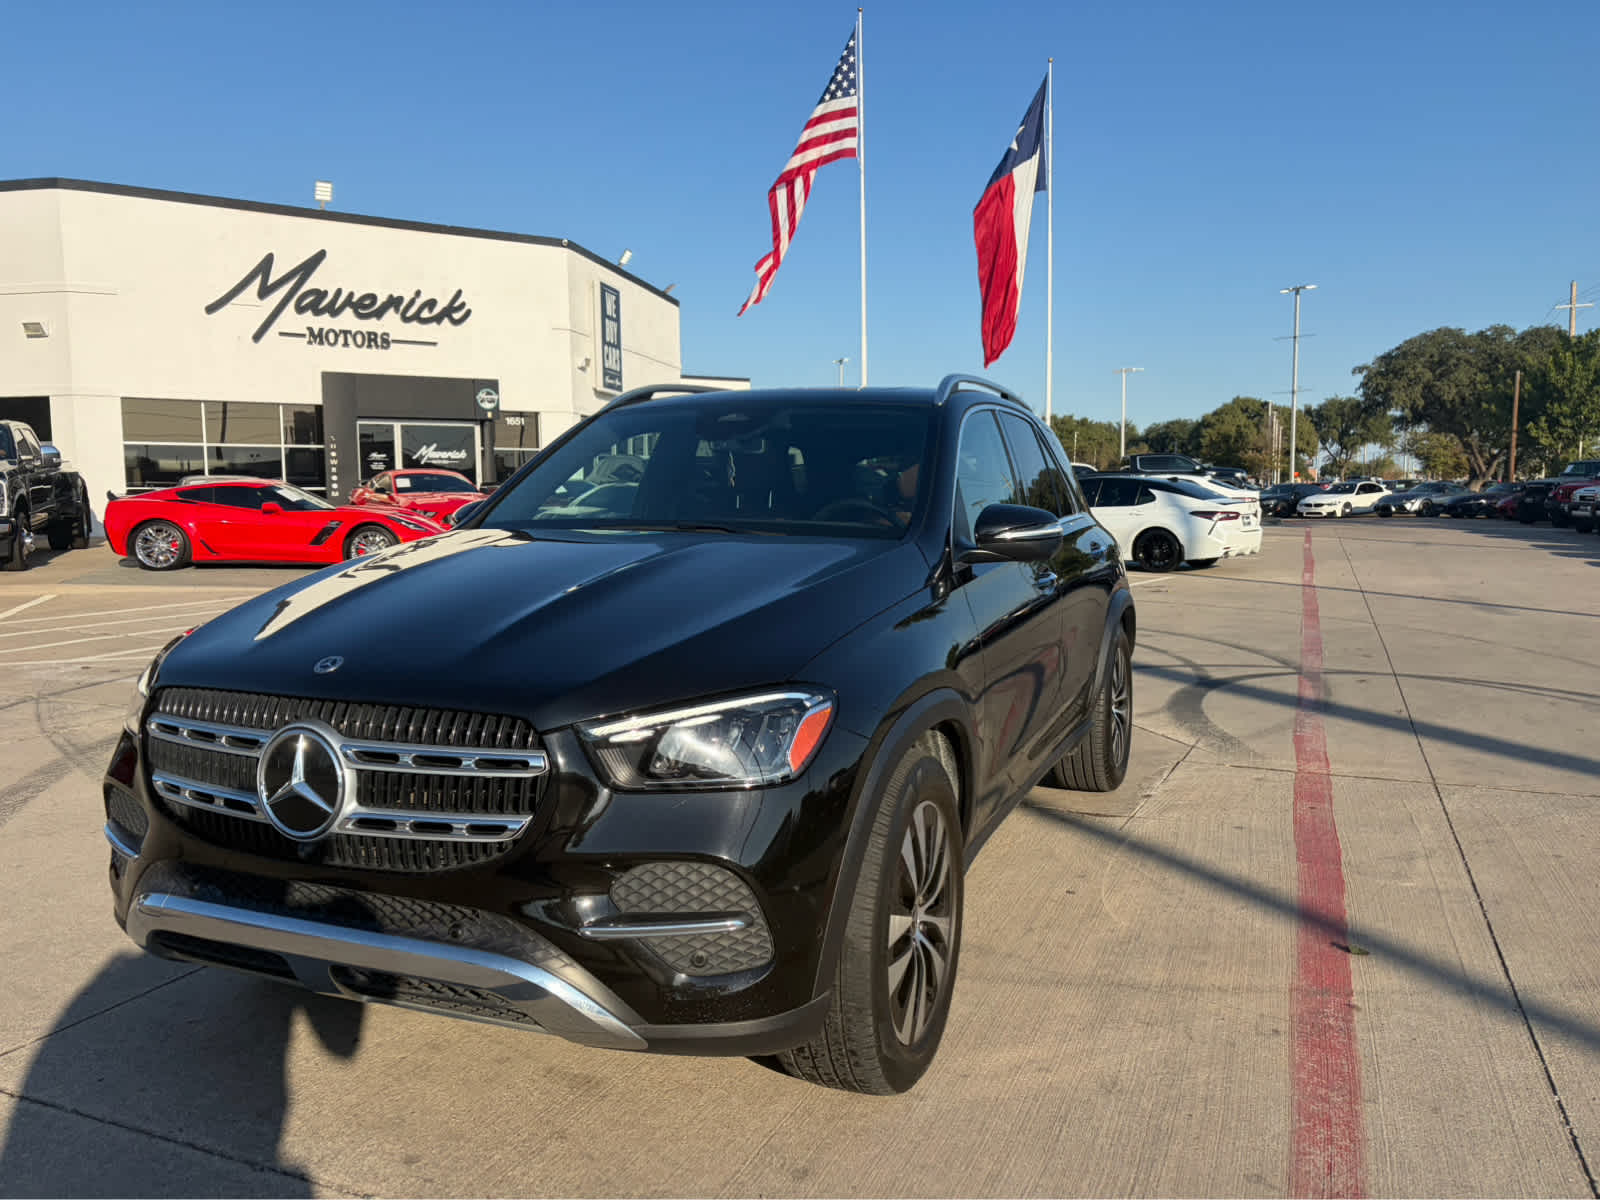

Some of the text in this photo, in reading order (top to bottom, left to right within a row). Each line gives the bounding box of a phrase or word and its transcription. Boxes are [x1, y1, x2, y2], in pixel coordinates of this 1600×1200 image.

[205, 249, 472, 344] Maverick
[605, 291, 617, 318] WE
[306, 326, 391, 350] MOTORS
[605, 319, 618, 345] BUY
[604, 345, 620, 372] CARS
[505, 417, 525, 426] 1651
